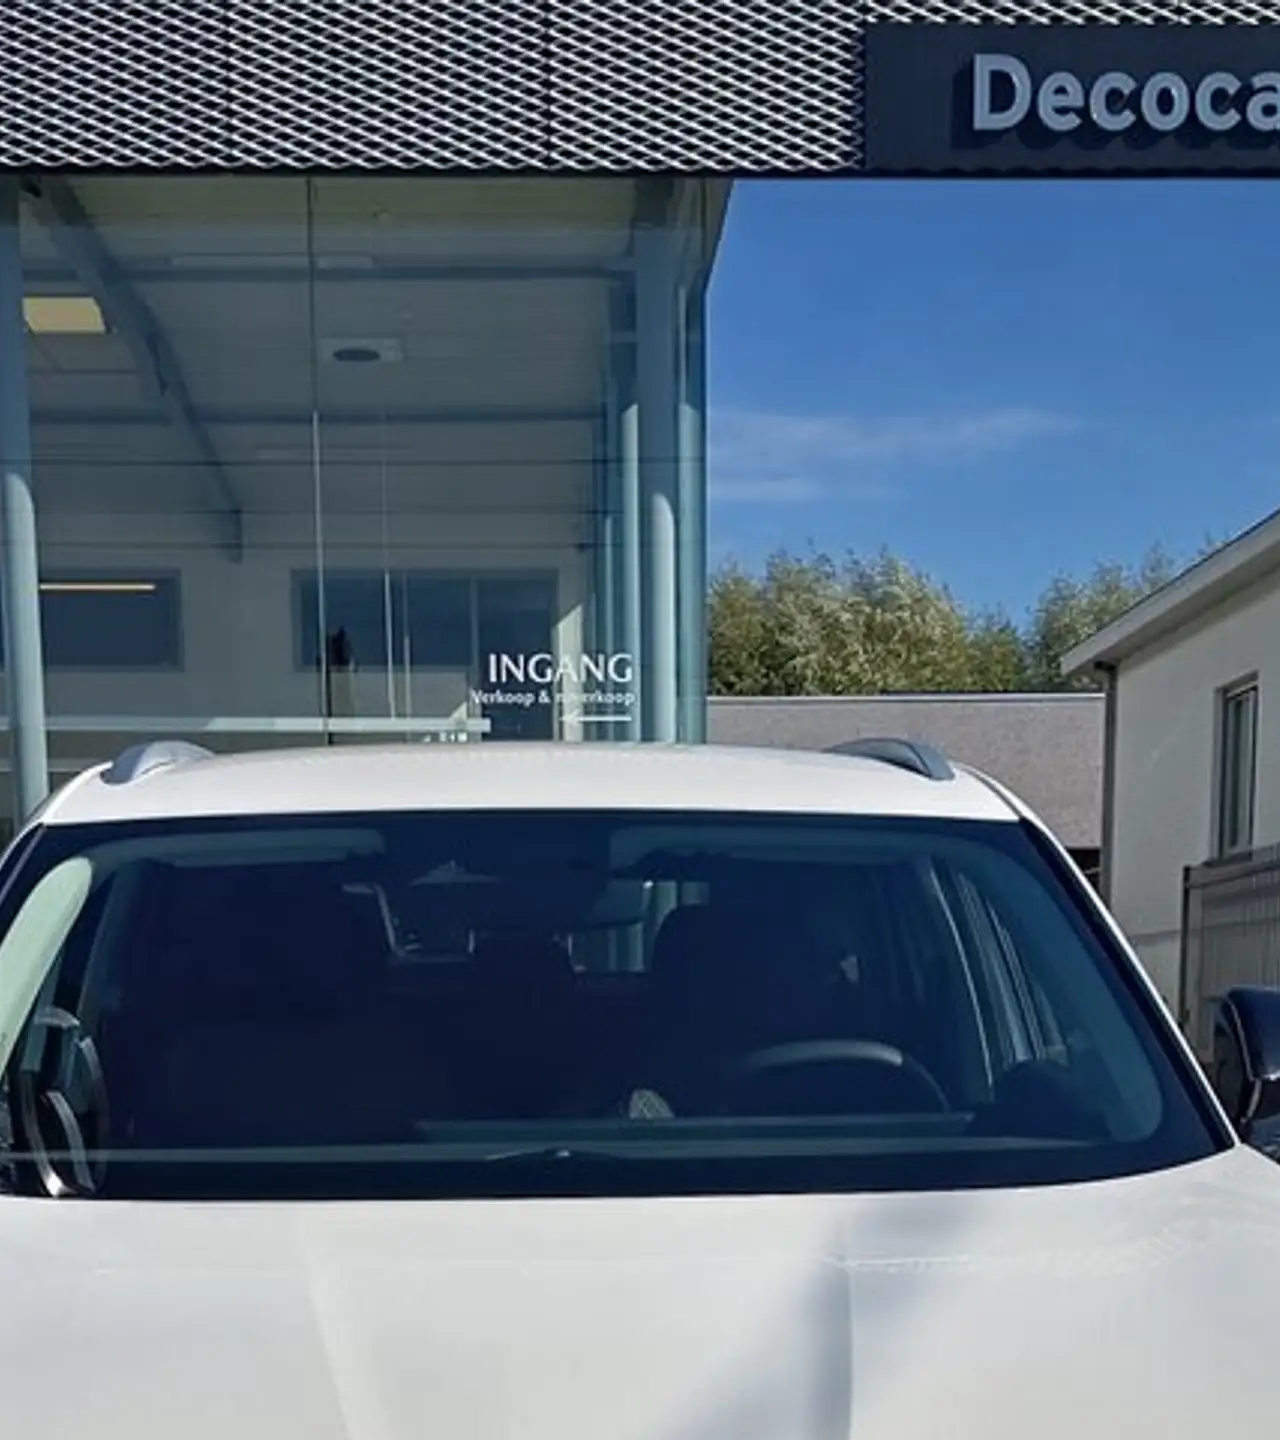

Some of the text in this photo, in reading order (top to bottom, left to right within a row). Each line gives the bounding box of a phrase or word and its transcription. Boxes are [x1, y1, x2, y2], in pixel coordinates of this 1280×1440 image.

[488, 653, 633, 683] INGANG
[471, 688, 536, 706] Verkoop
[539, 690, 551, 704] &
